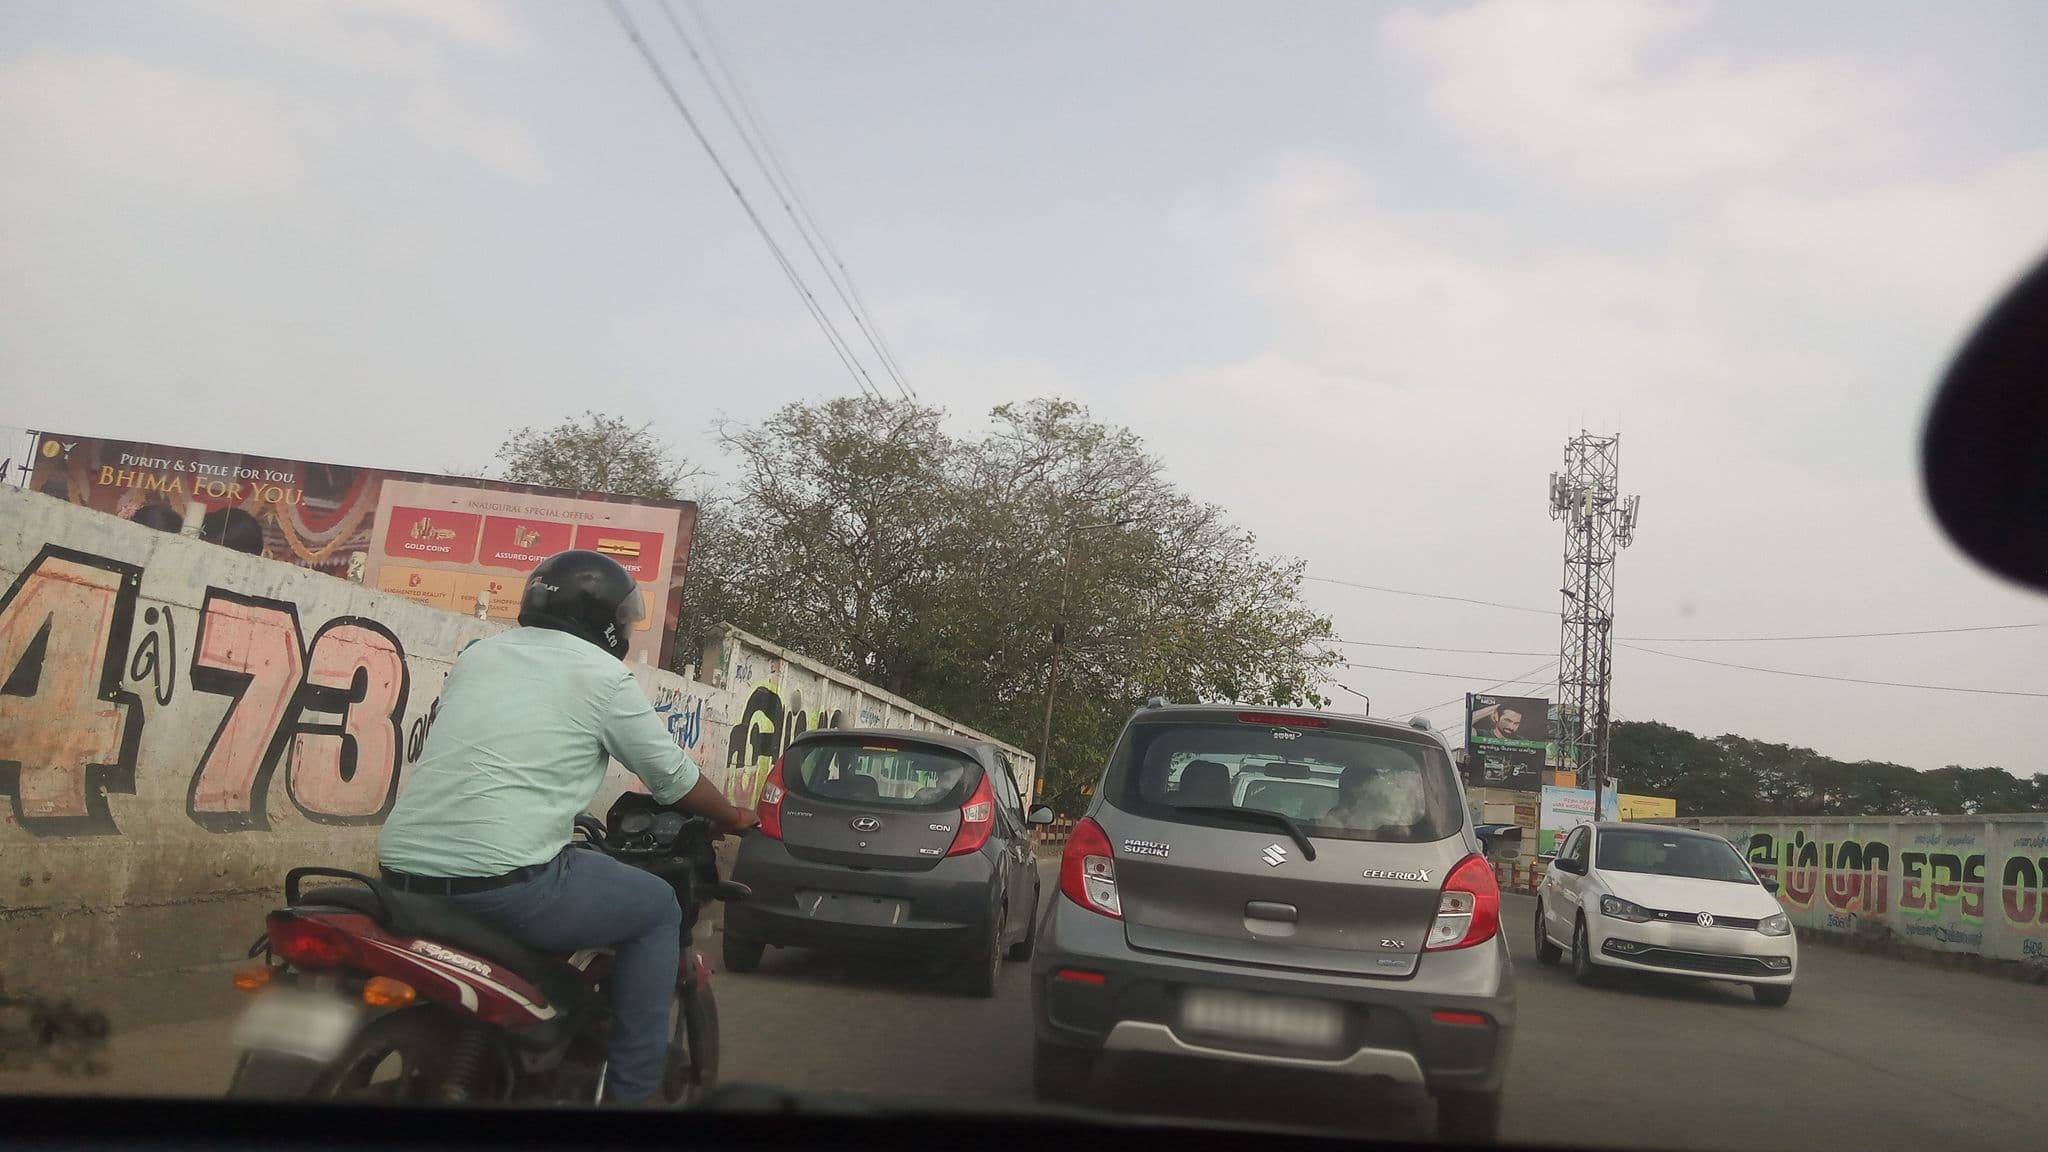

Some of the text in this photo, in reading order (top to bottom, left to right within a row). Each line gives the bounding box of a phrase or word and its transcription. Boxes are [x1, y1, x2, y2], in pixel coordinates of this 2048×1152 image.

[173, 459, 186, 472] &
[98, 465, 184, 494] BHIMA
[468, 501, 595, 521] INAUGURAL SPECIAL OFFERS
[404, 542, 426, 551] GOLD
[495, 552, 528, 561] ASSURED
[0, 542, 144, 836] 4
[187, 585, 411, 832] 73
[929, 824, 951, 832] EON
[1124, 839, 1170, 850] MARUTI
[1123, 845, 1170, 858] SUZUKI
[1901, 852, 1985, 918] EPS
